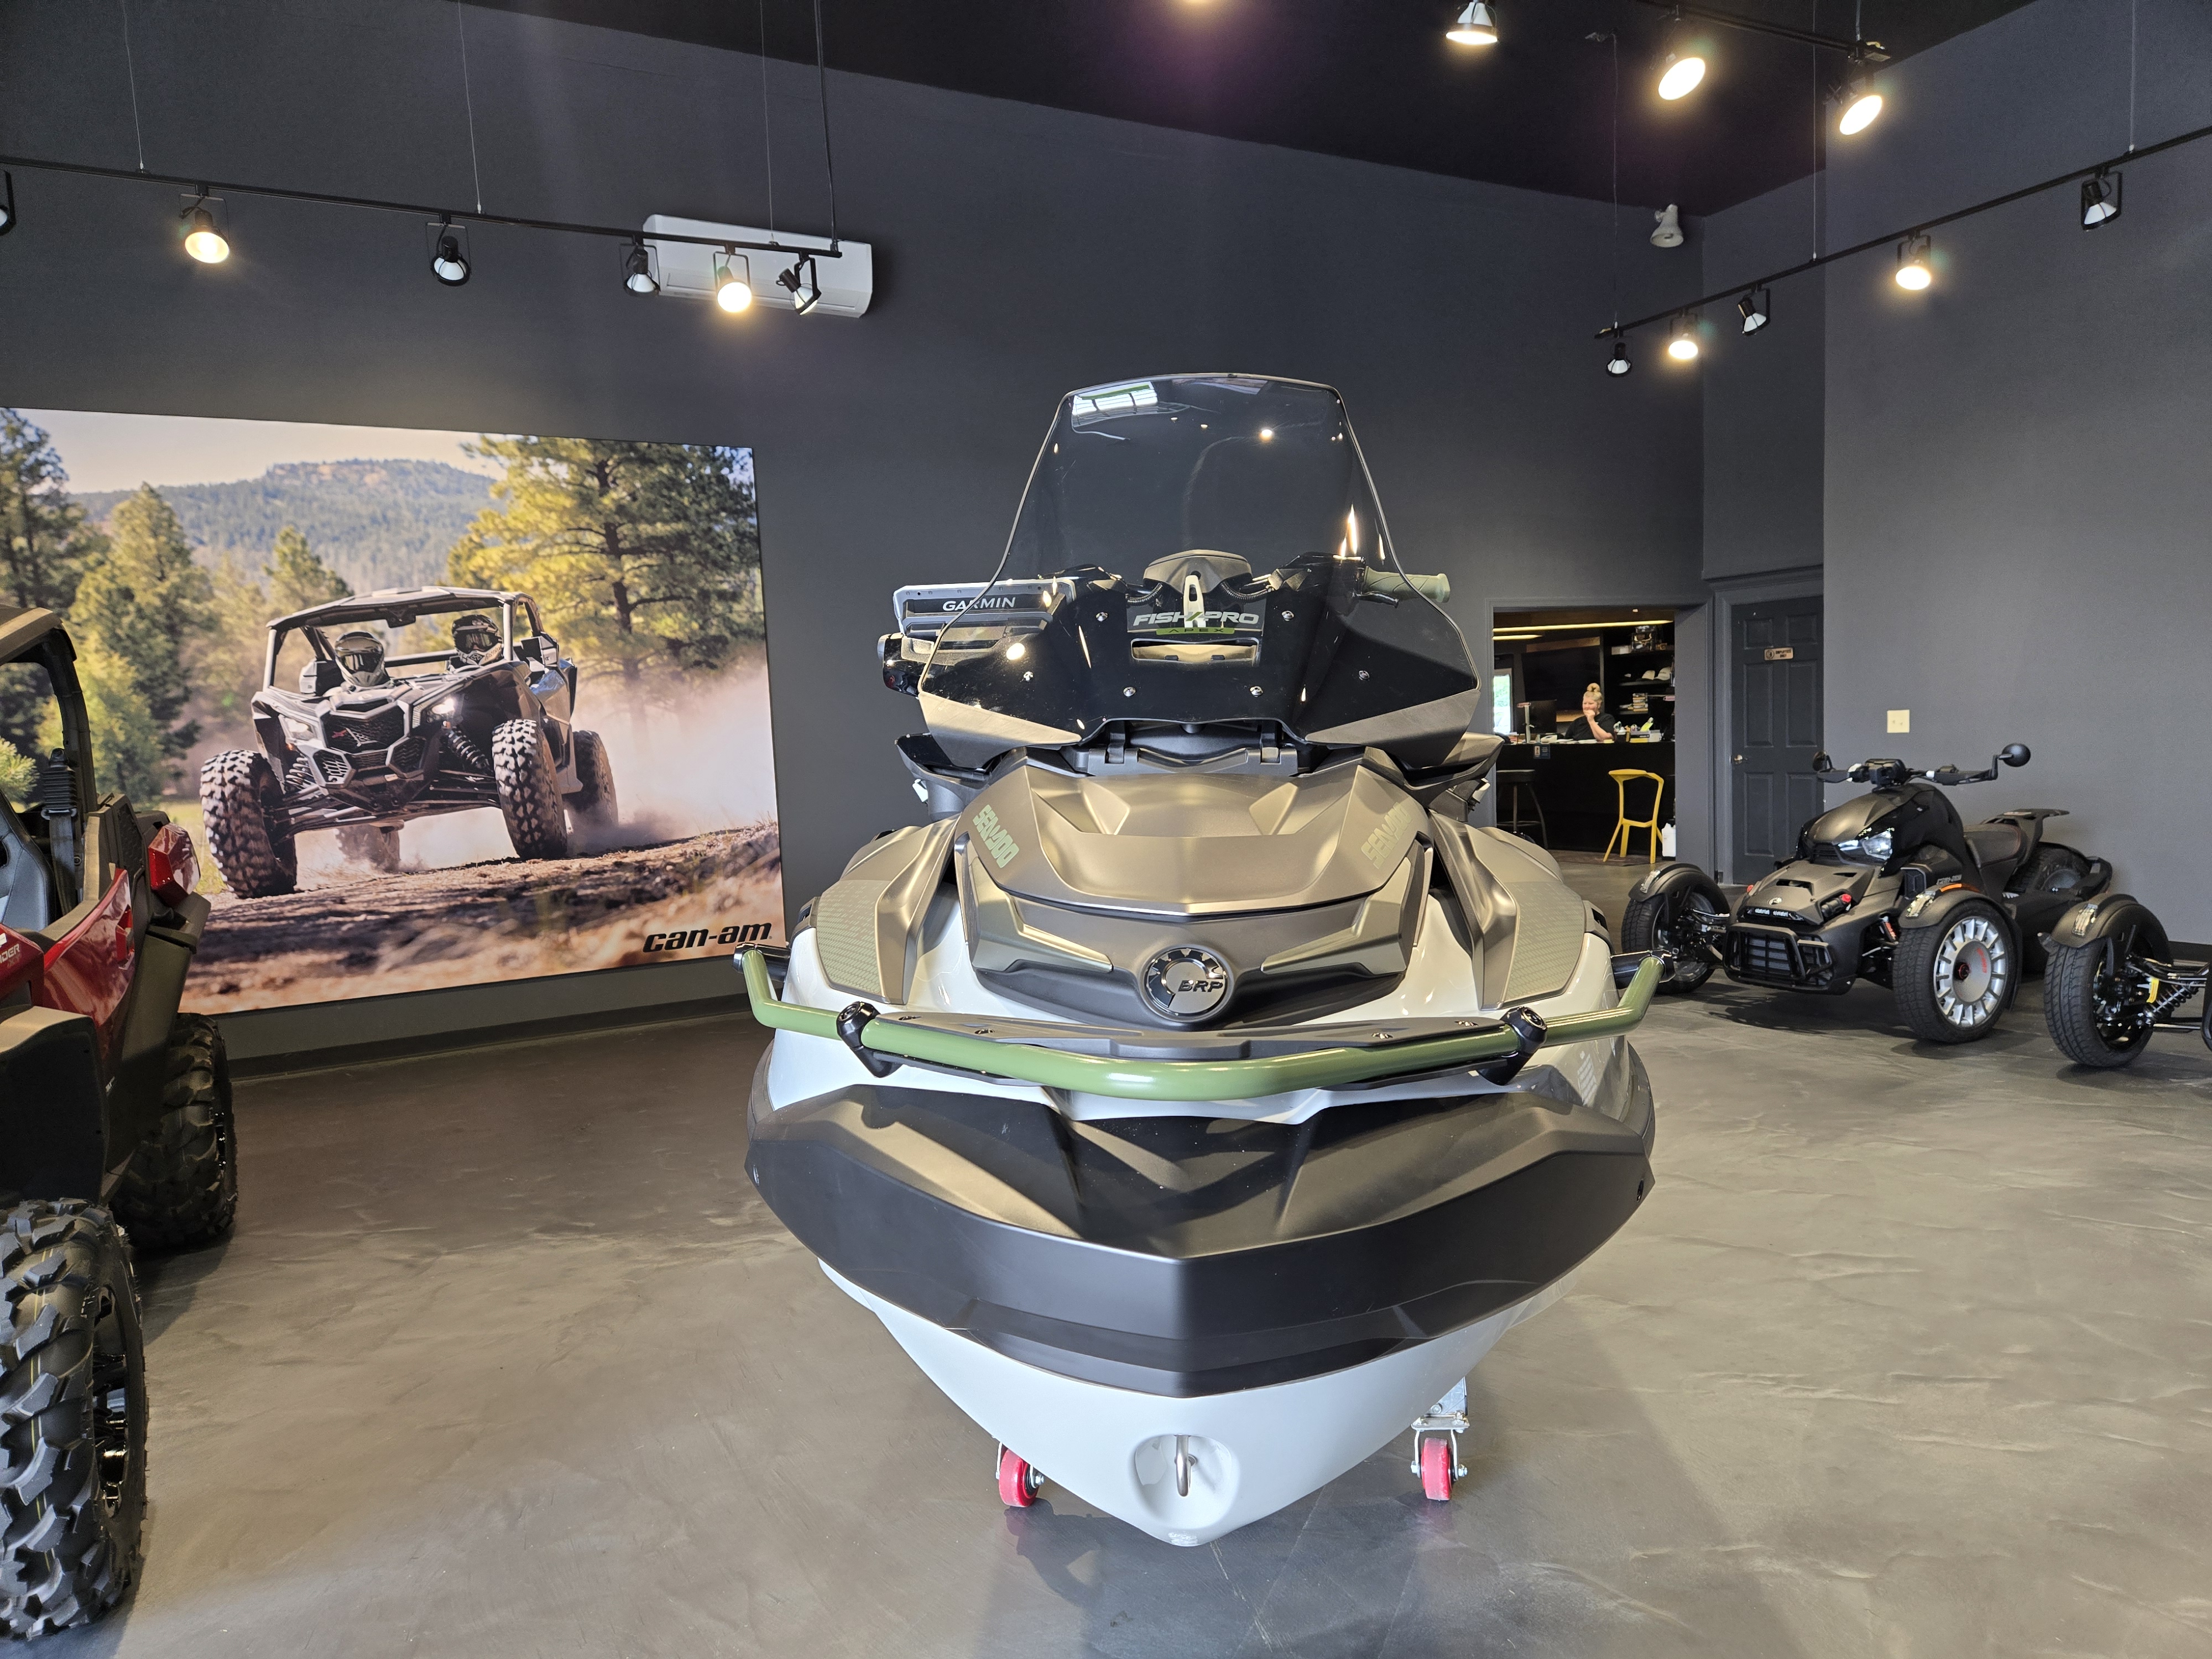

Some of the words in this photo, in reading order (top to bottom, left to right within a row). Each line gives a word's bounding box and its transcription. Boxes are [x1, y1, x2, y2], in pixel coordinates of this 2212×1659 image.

[942, 597, 1016, 611] GARMIN
[643, 922, 772, 952] can-am
[1178, 980, 1224, 993] BRP
